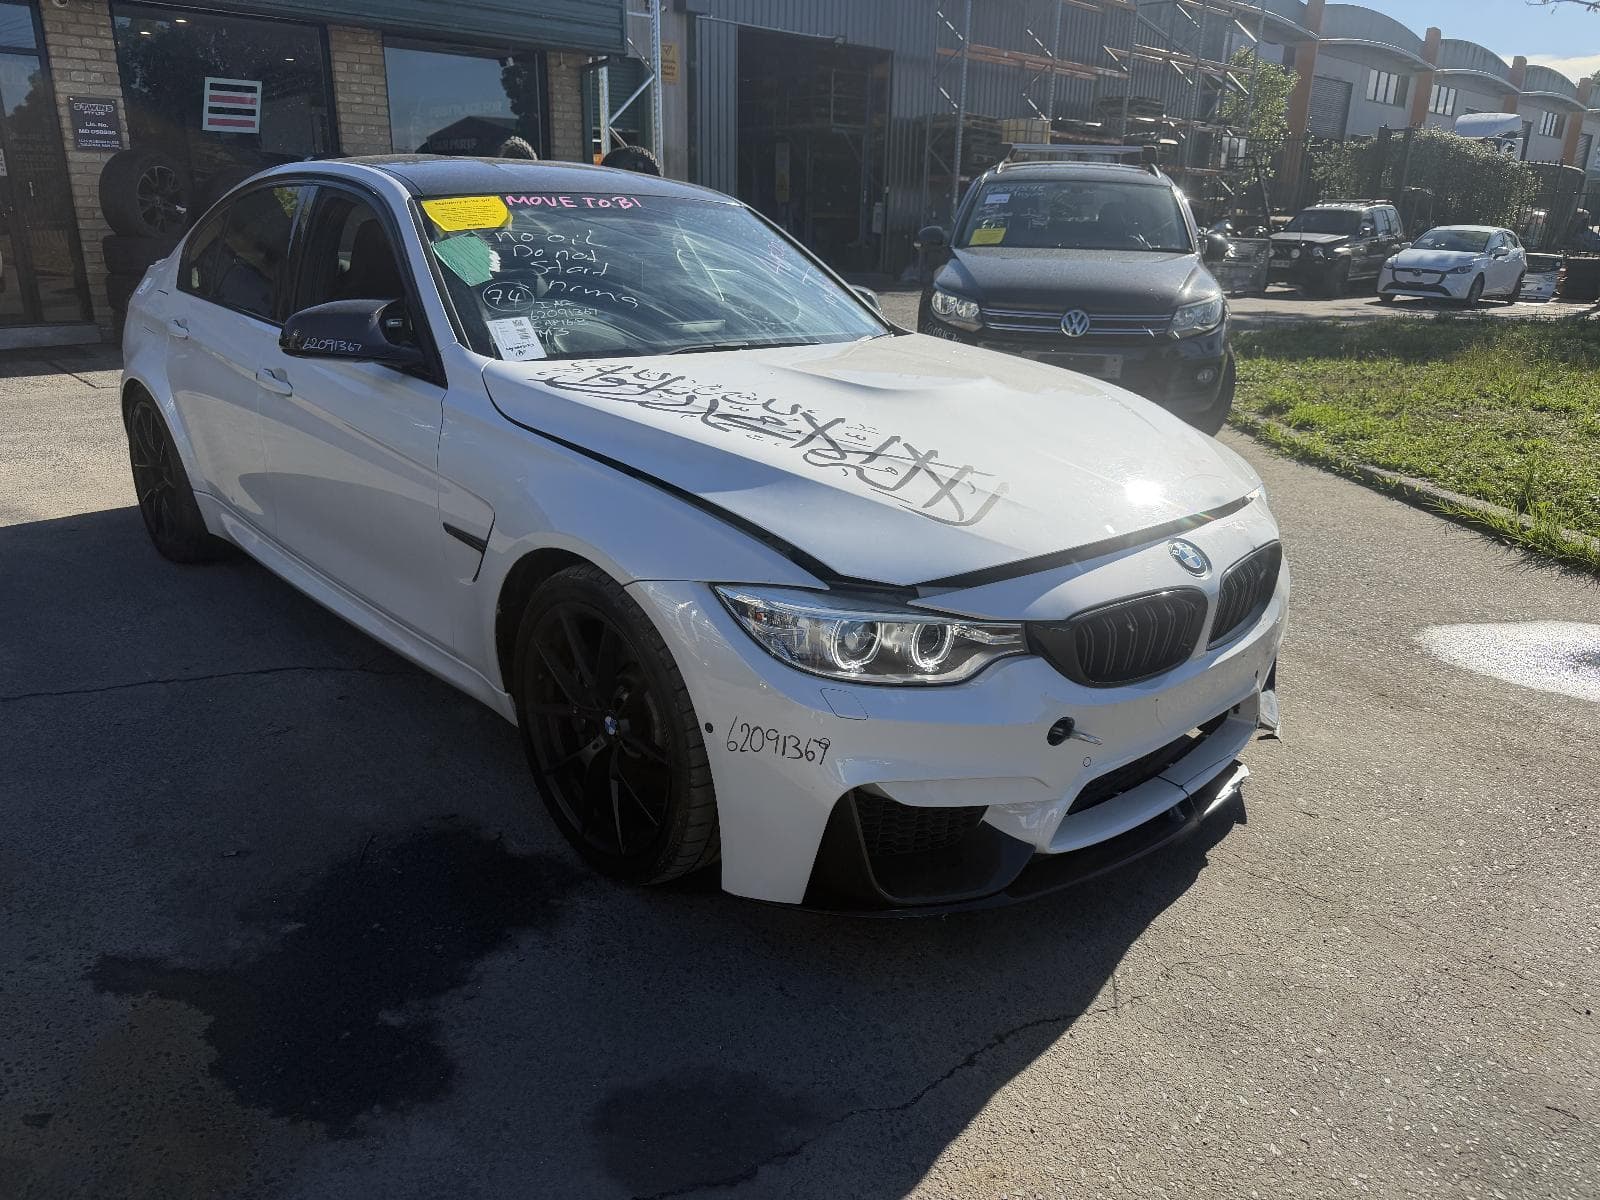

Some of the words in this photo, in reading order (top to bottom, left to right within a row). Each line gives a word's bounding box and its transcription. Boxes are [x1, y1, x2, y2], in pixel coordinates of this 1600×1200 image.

[506, 195, 578, 208] MOVE
[513, 244, 544, 257] Do
[555, 249, 597, 263] not
[487, 288, 522, 310] 74
[302, 337, 362, 352] 62091367
